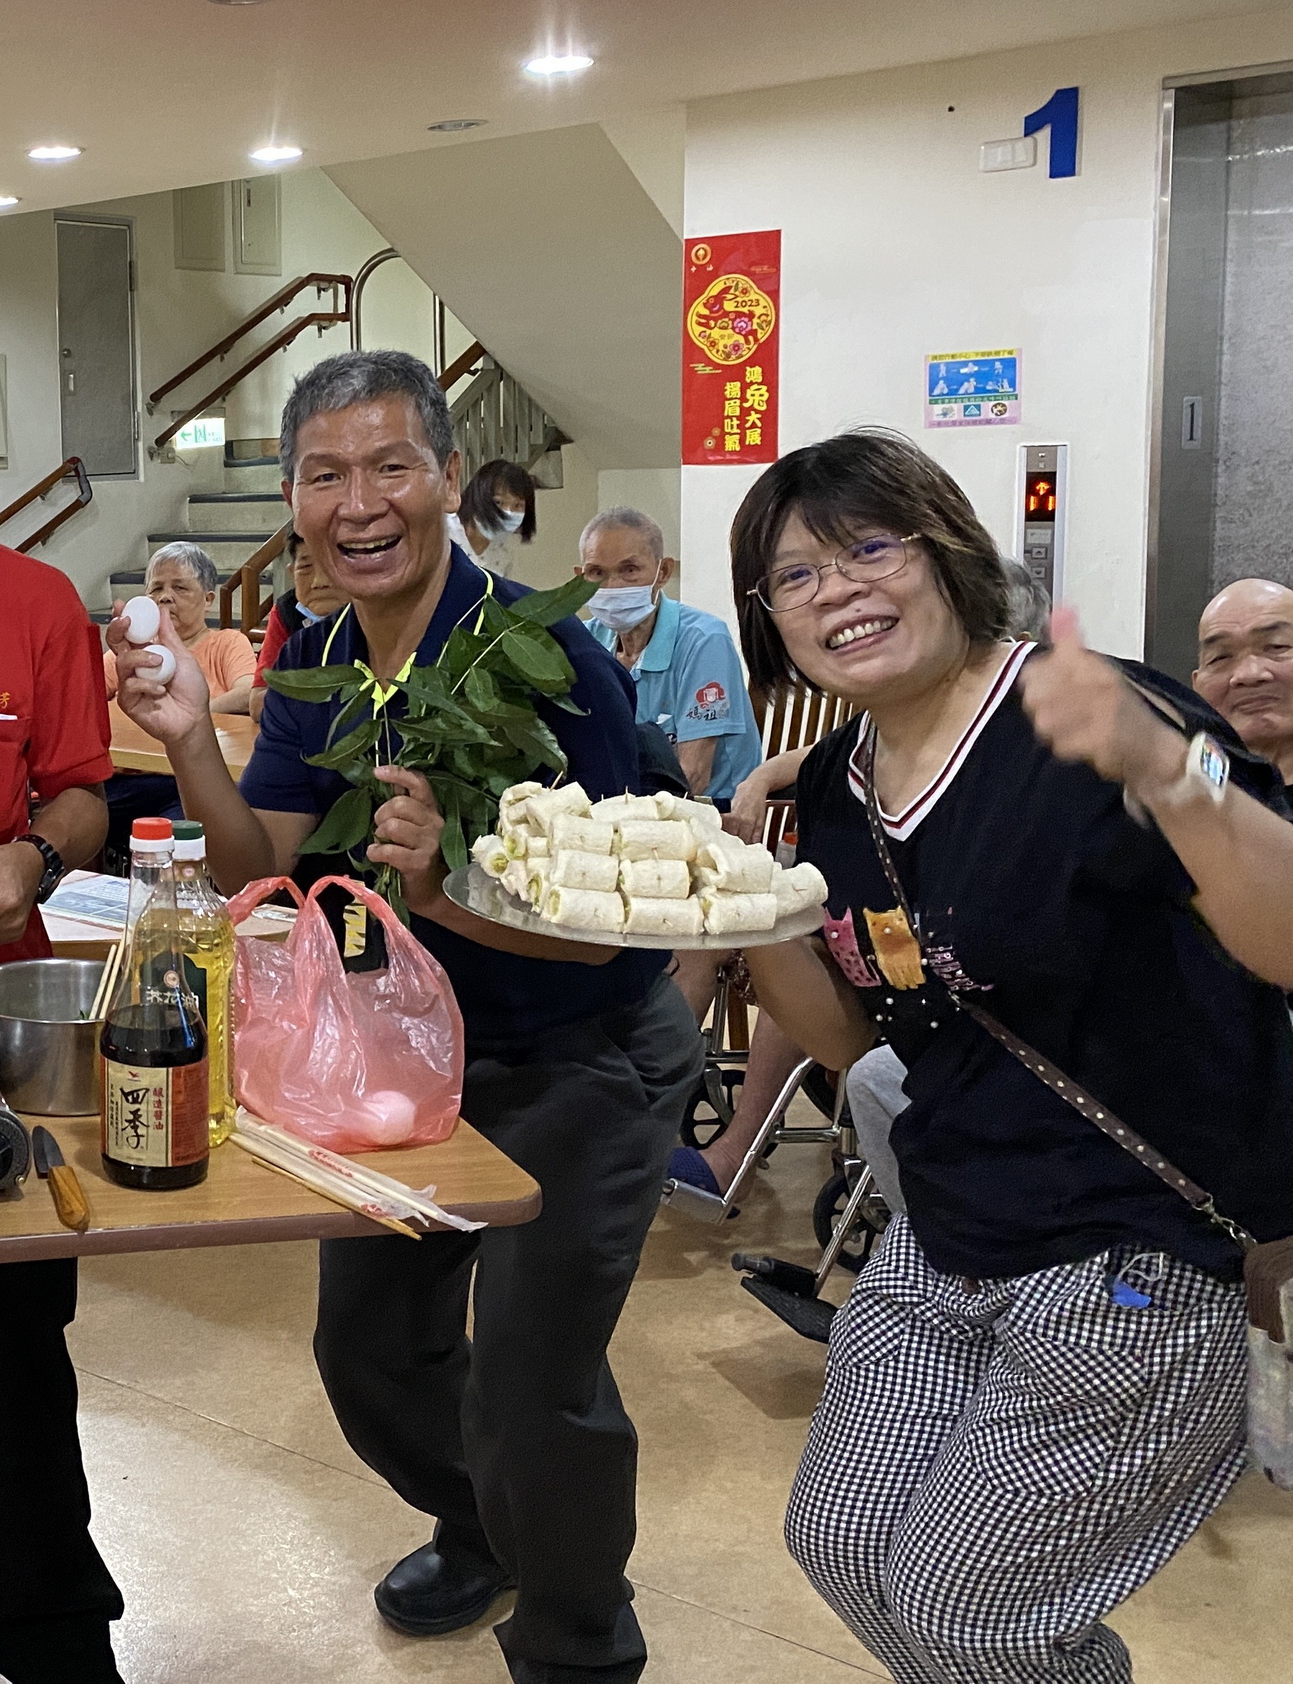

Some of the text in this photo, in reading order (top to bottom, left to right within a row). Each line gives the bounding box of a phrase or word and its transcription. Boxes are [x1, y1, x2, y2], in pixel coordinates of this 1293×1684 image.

[1023, 86, 1080, 179] 1
[734, 299, 760, 308] 2023
[724, 381, 741, 451] 揚眉吐氣
[743, 366, 769, 446] 鴻兔大展
[1186, 402, 1197, 441] 1
[120, 1087, 150, 1149] 四季
